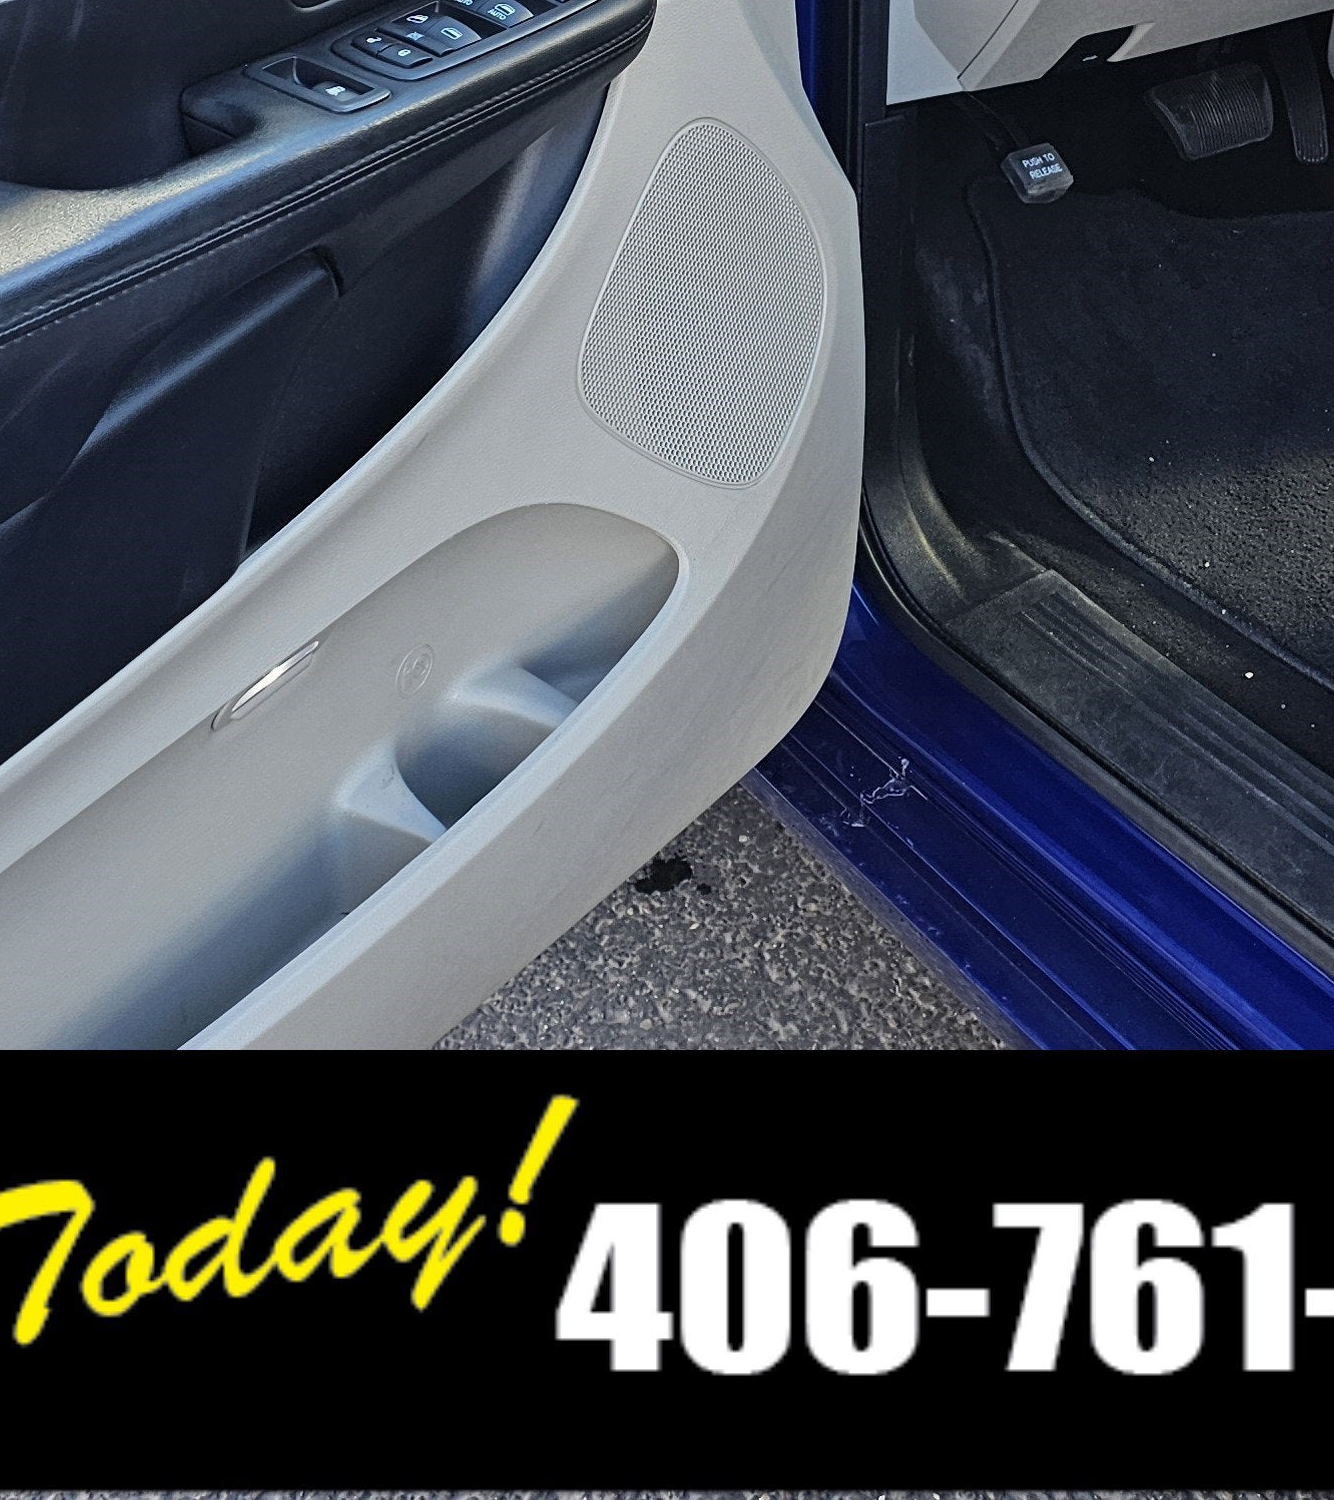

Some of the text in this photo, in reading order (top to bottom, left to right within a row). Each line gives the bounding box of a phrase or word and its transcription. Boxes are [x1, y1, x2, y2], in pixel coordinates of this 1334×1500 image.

[487, 9, 507, 20] AUTO
[1022, 153, 1055, 168] PUSH TO
[1029, 163, 1063, 180] RELEASE
